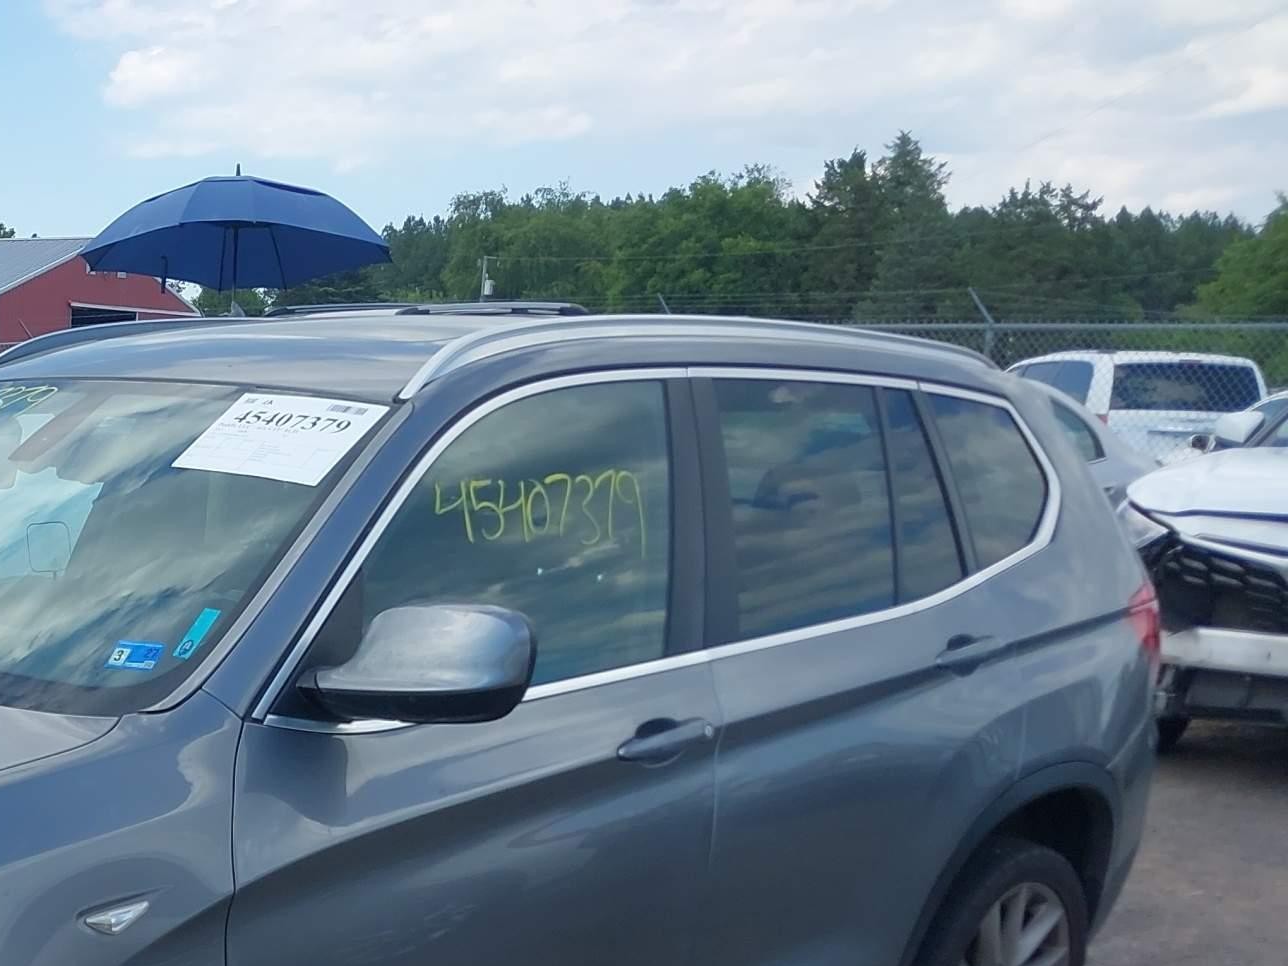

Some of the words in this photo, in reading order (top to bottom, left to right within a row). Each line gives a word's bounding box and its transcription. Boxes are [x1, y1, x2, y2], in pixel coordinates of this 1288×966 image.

[234, 410, 352, 433] 45407379
[435, 469, 646, 559] 45407379
[113, 649, 125, 662] 3
